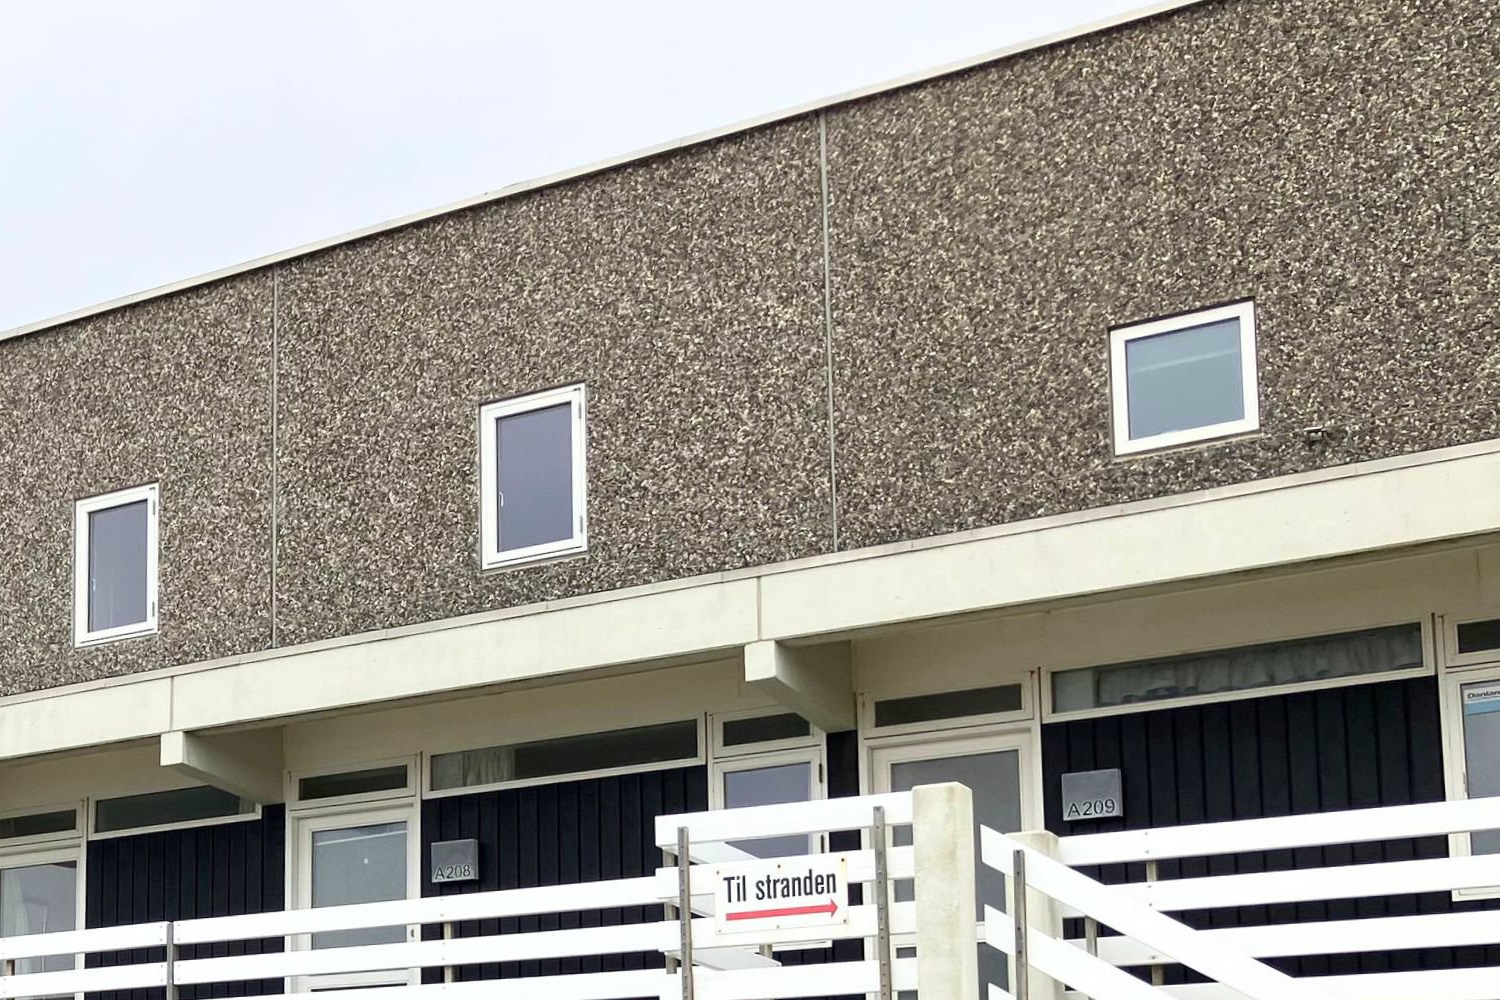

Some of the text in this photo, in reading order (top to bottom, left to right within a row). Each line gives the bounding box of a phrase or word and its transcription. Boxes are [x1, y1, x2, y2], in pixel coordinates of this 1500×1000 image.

[1067, 798, 1116, 818] A209
[435, 864, 471, 880] A208
[723, 869, 837, 903] Til stranden
